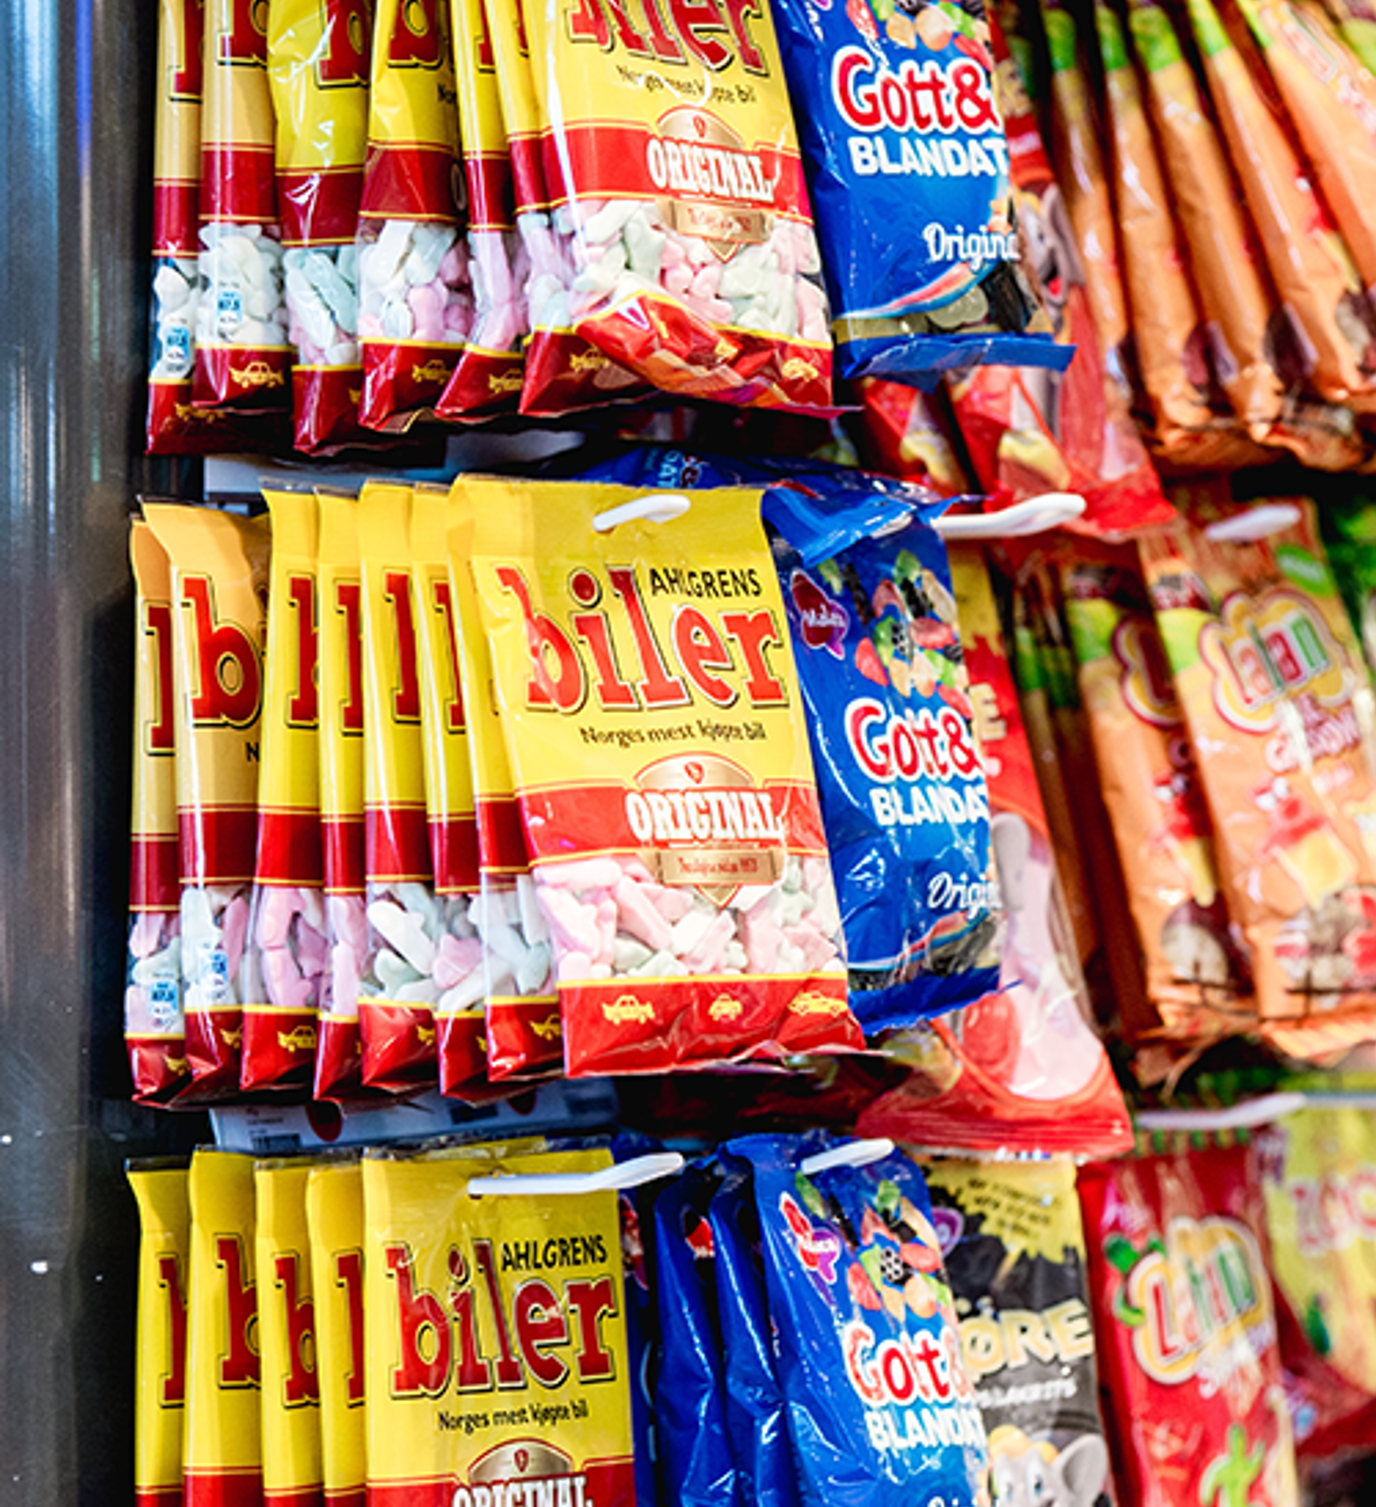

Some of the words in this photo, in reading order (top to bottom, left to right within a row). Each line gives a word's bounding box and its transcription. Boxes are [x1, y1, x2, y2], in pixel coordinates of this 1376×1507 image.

[646, 137, 774, 203] ORIGINAL
[649, 567, 763, 598] AHLGRENS
[494, 563, 790, 716] biler
[578, 726, 645, 748] Norges
[647, 724, 696, 743] mest
[625, 791, 783, 840] ORIGINAL
[501, 1235, 607, 1271] AHLGRENS
[384, 1238, 619, 1400] biler
[438, 1410, 490, 1434] Norges
[570, 1399, 589, 1418] bil
